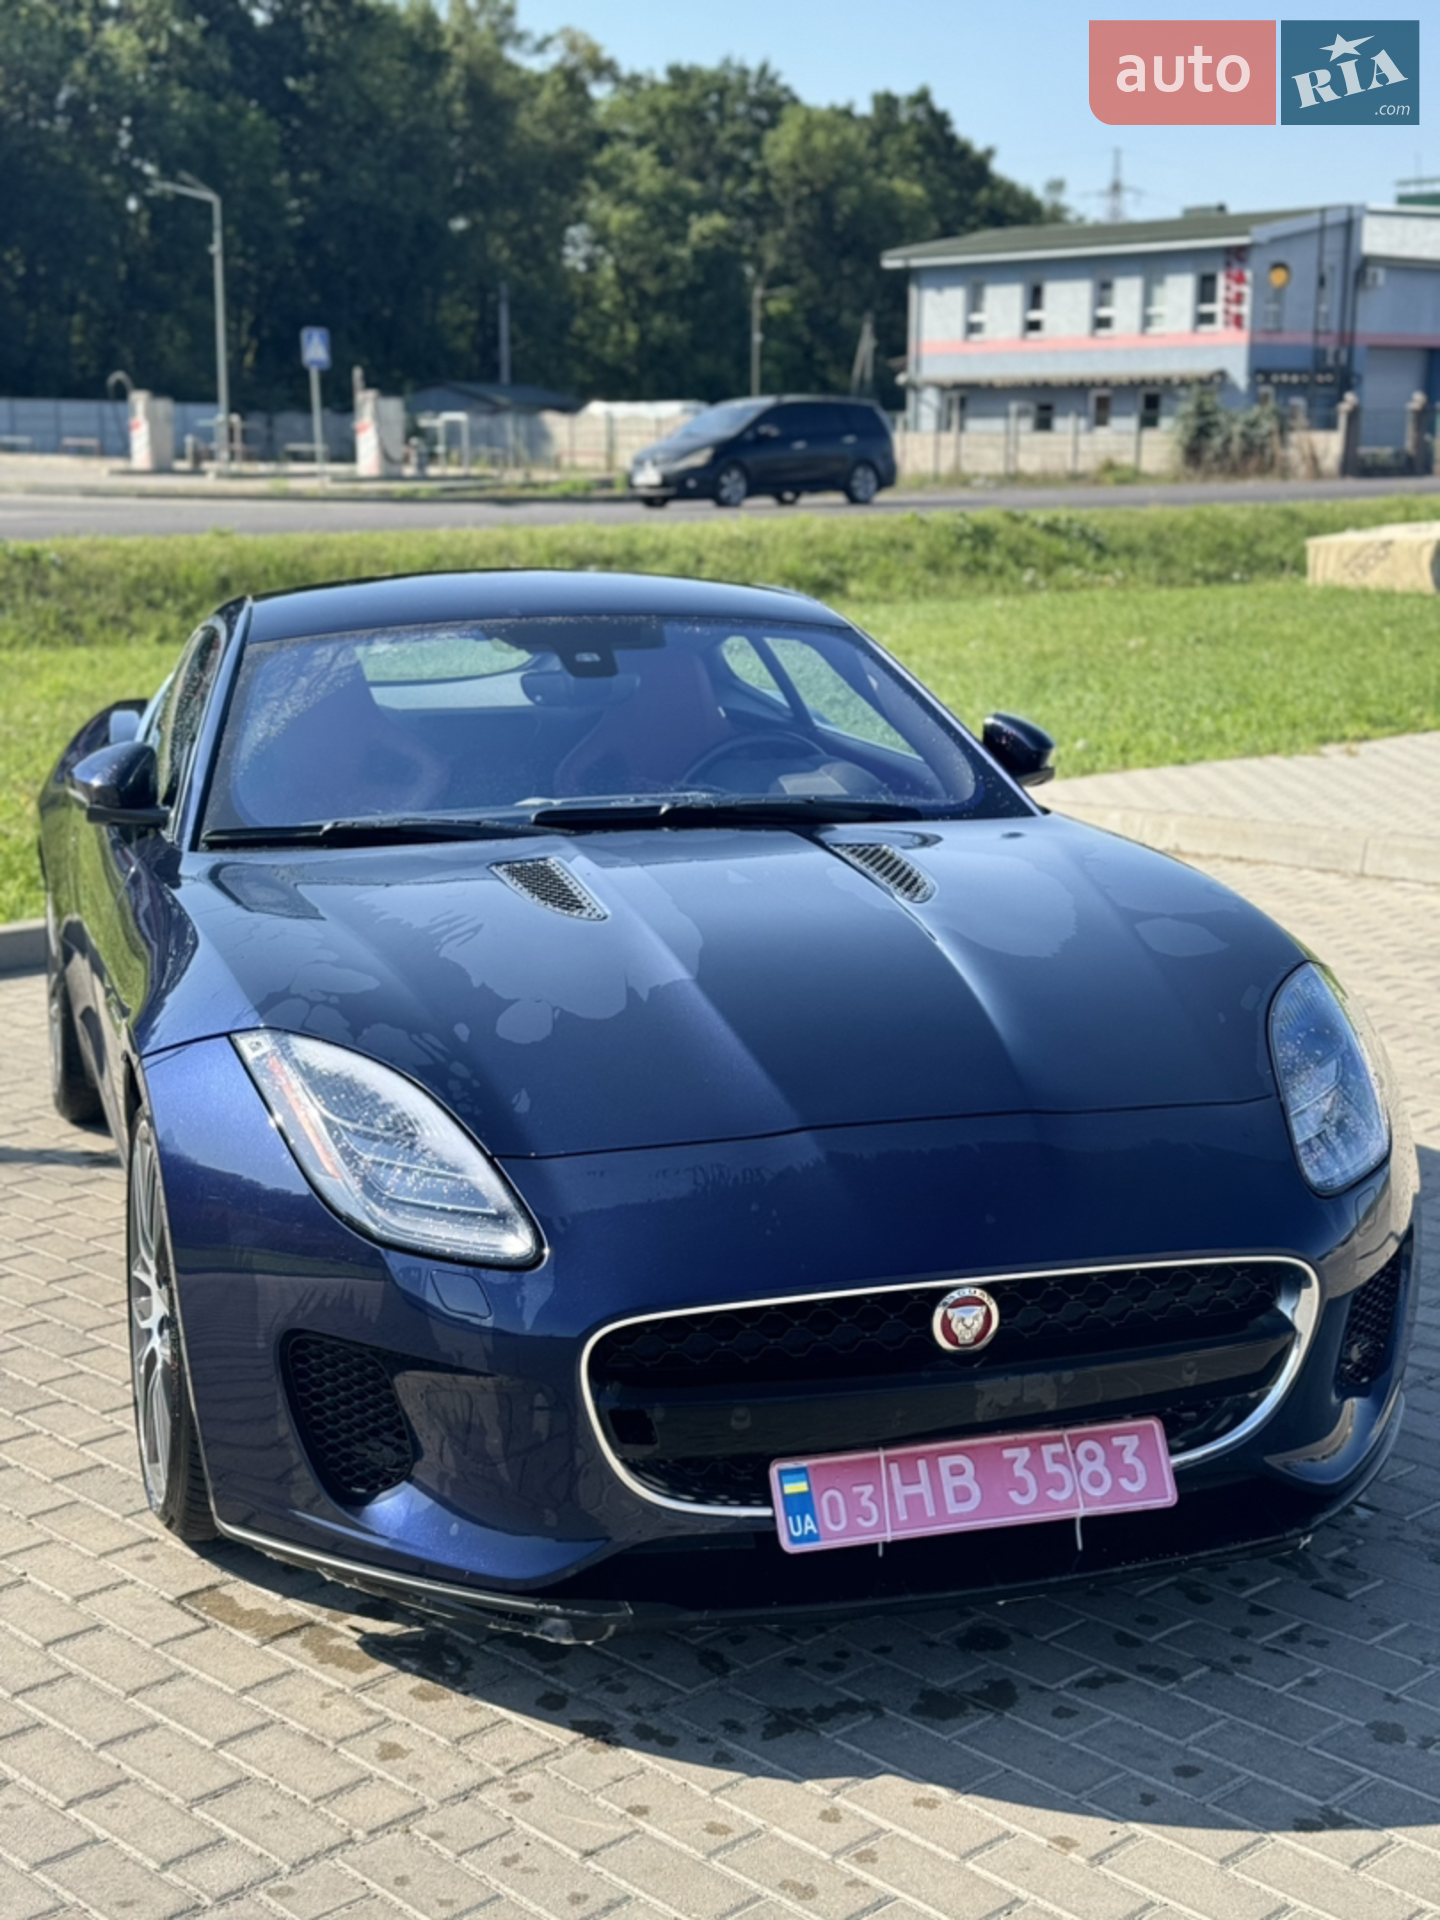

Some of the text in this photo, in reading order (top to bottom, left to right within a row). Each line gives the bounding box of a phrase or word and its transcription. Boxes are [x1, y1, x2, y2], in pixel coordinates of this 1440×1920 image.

[820, 1435, 1148, 1533] 03 HB 3583
[787, 1513, 818, 1538] UA
